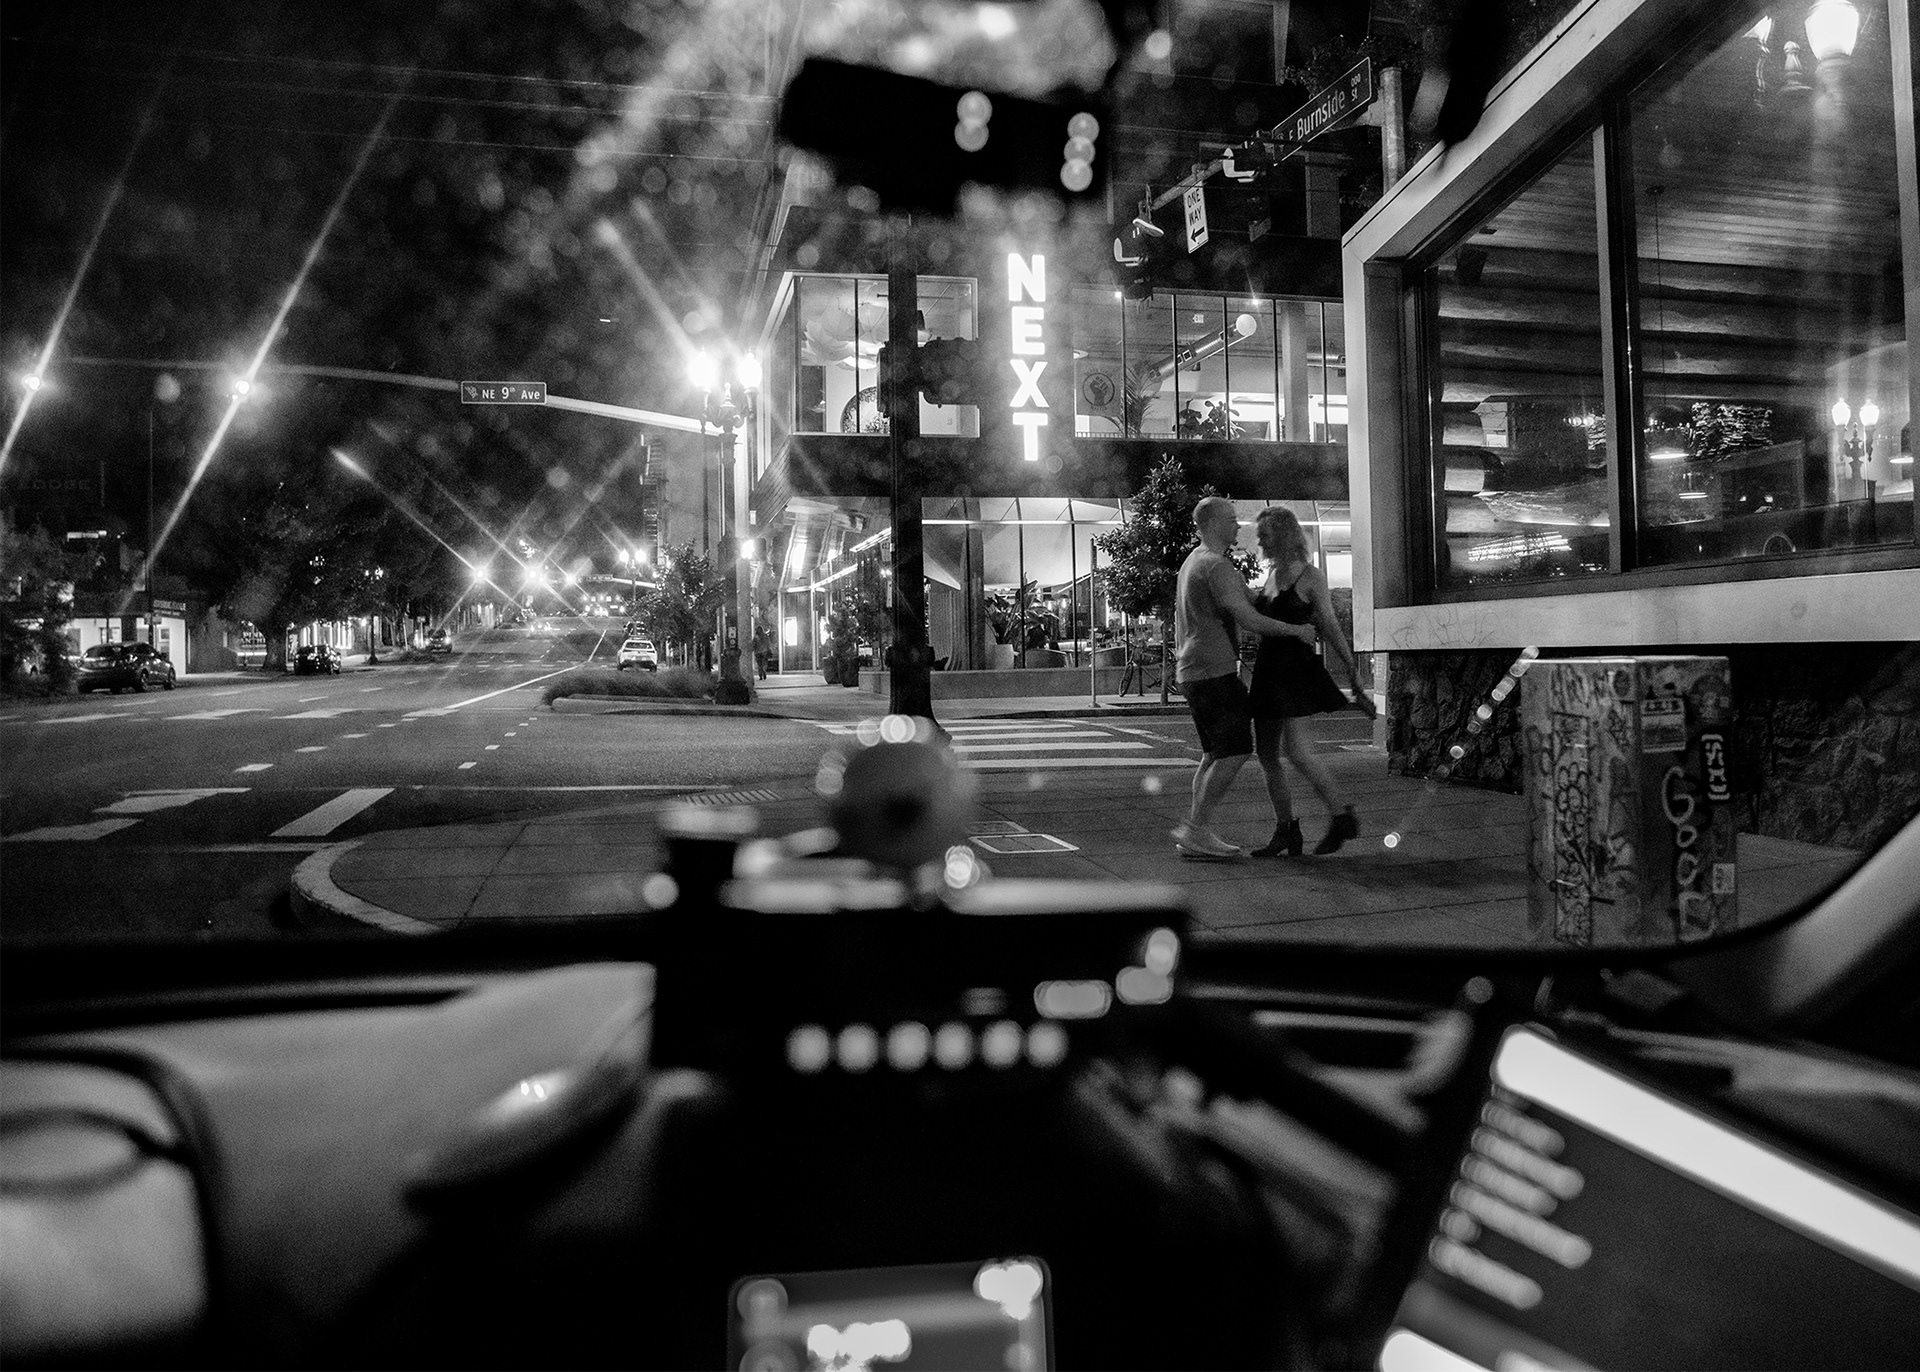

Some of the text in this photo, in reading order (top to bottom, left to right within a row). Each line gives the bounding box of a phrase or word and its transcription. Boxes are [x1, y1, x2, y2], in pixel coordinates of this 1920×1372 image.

[1296, 90, 1346, 141] Burnside
[1186, 188, 1202, 208] ONE
[1187, 205, 1203, 226] WAY
[1007, 252, 1050, 462] NEXT
[481, 386, 541, 400] NE 9th Ave
